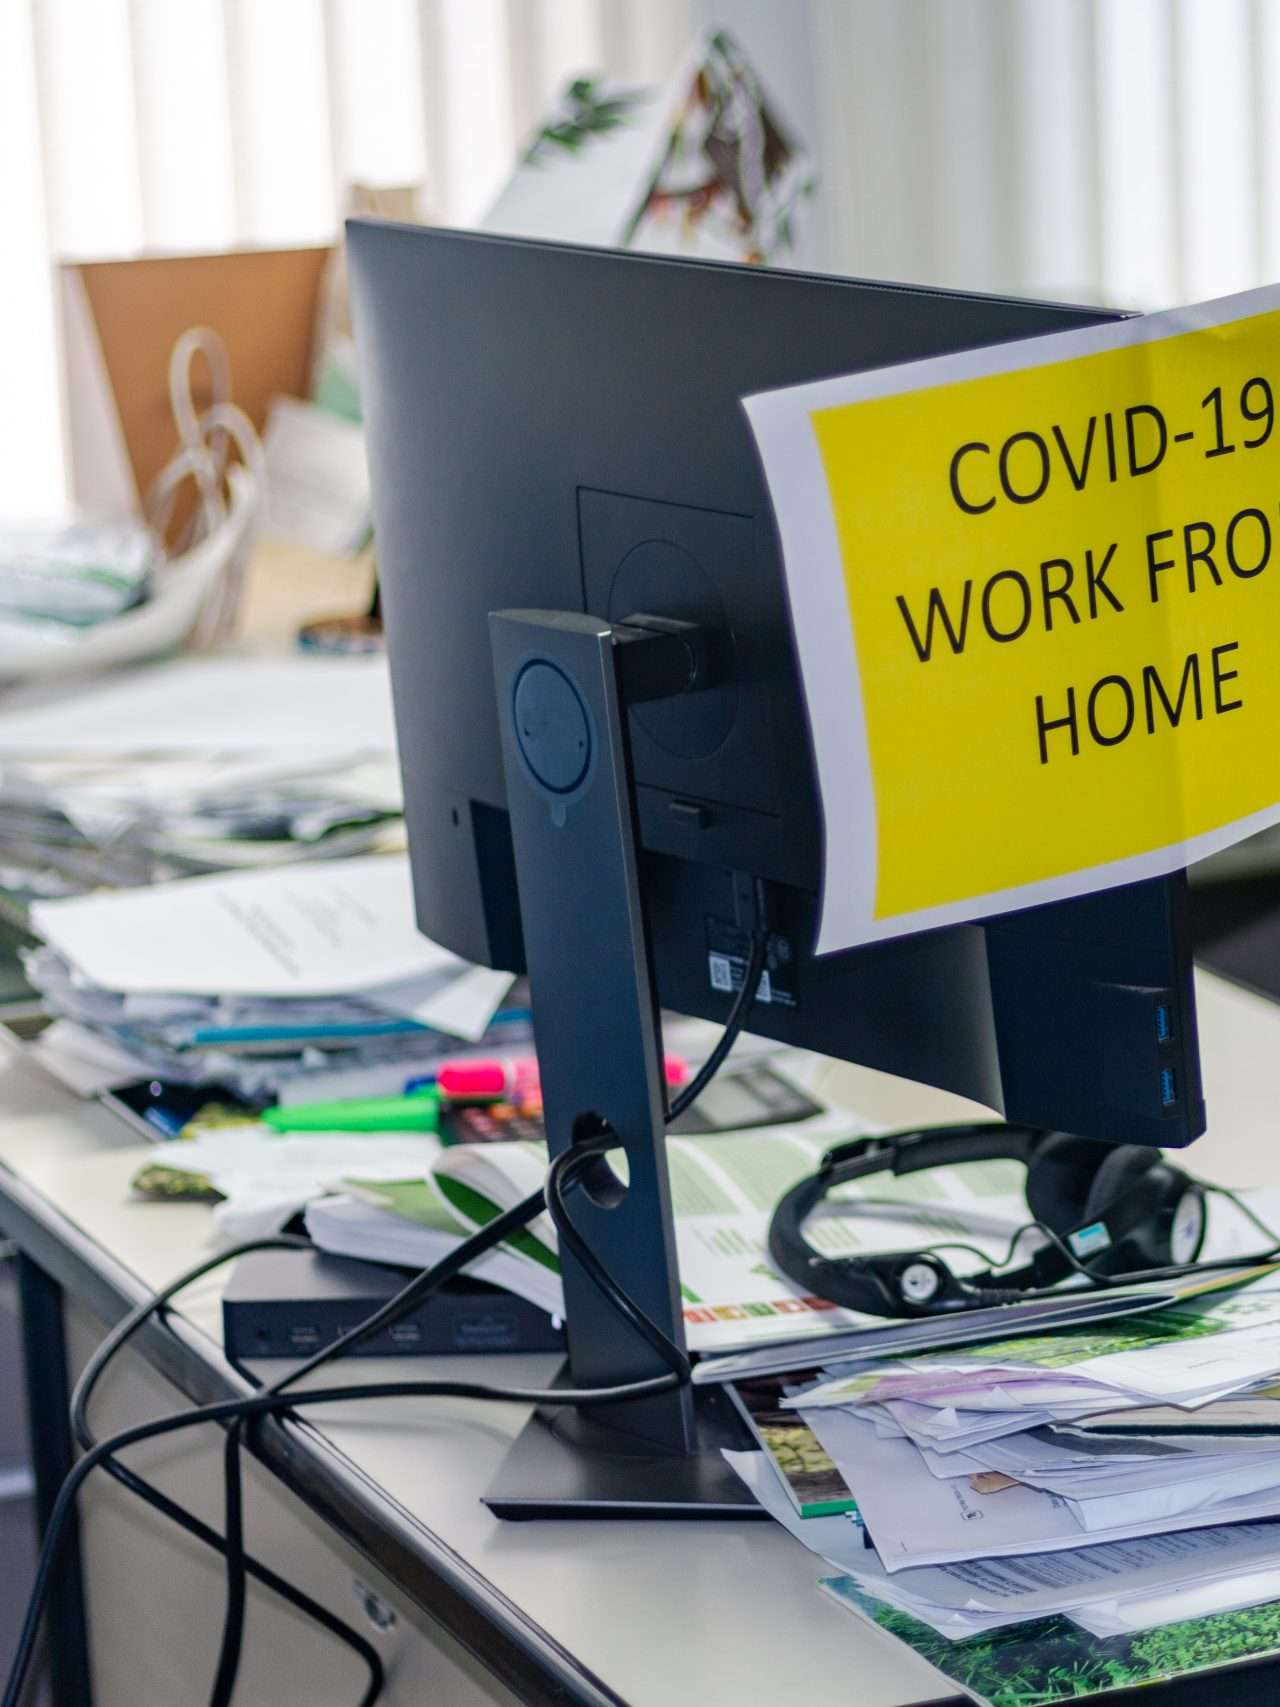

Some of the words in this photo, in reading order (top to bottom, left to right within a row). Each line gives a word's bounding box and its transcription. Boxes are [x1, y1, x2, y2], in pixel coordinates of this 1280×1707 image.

[949, 377, 1275, 515] COVID-19
[896, 543, 1125, 662] WORK
[1035, 642, 1243, 764] HOME
